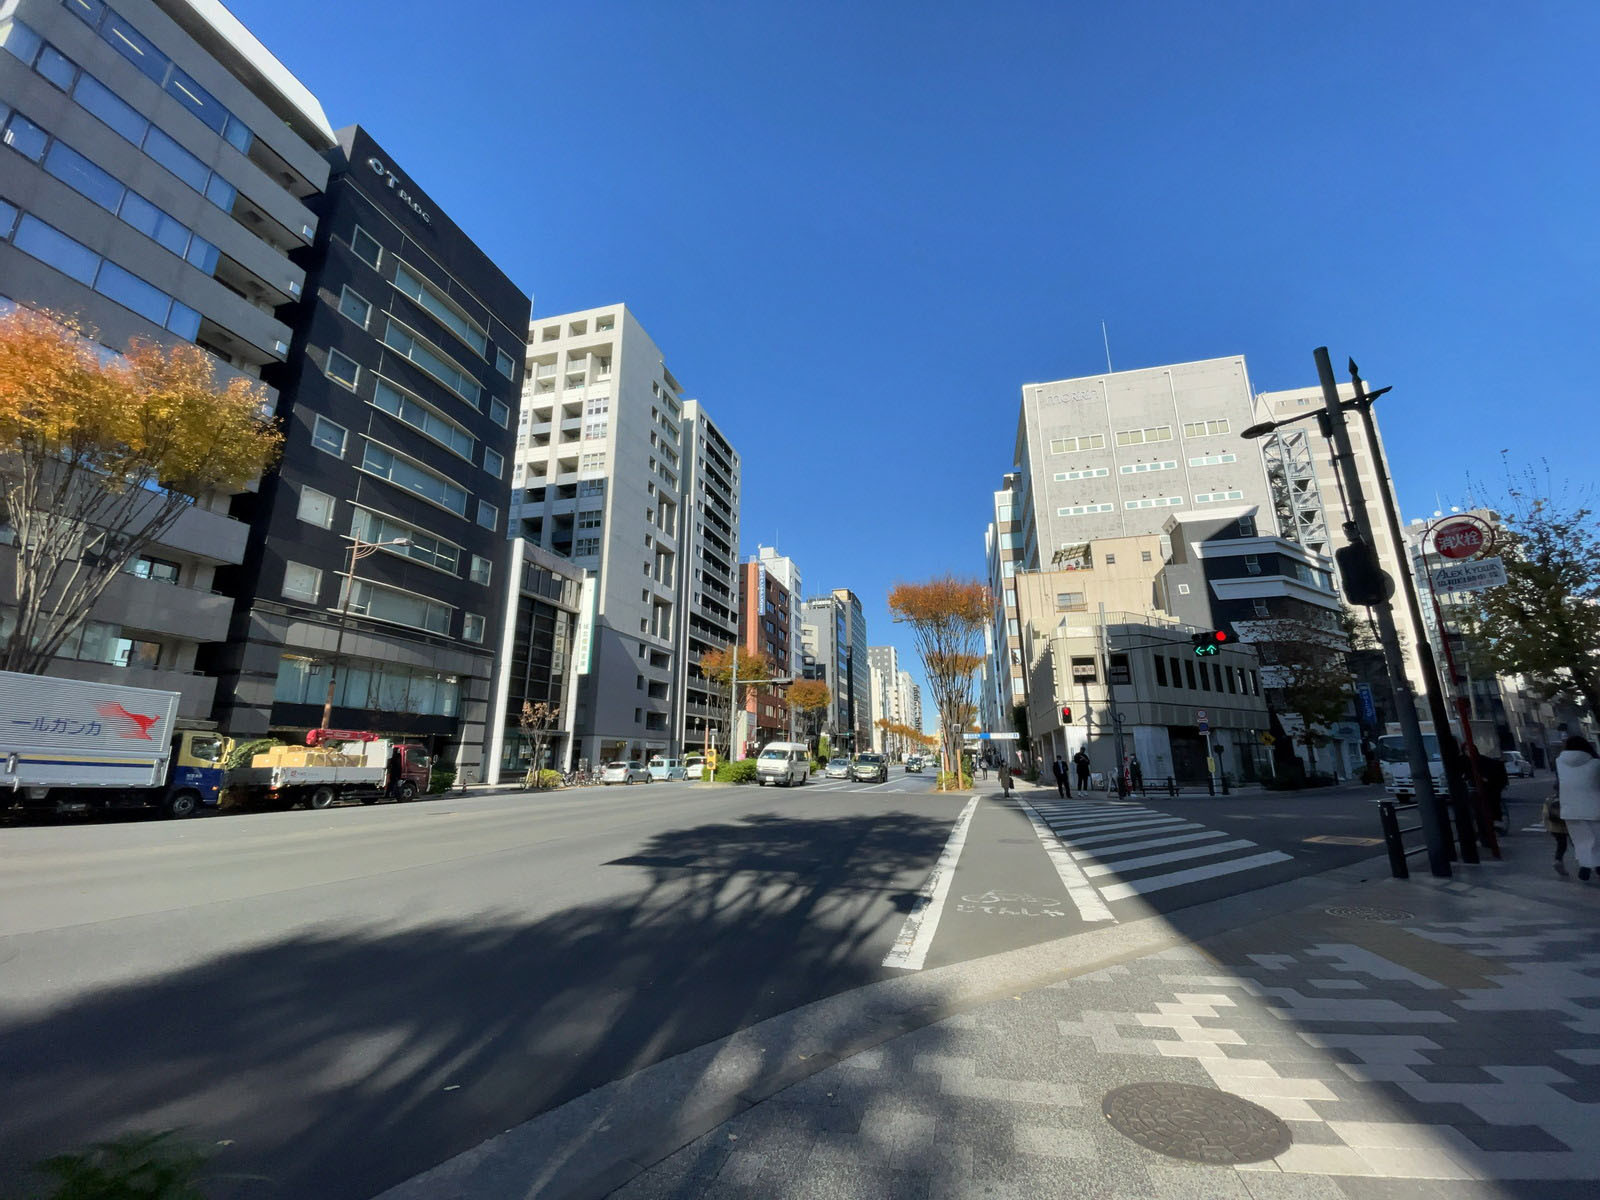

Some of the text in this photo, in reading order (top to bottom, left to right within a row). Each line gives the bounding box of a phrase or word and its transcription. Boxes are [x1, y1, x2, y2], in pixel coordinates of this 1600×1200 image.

[1438, 531, 1480, 550] 消火栓
[1435, 568, 1463, 580] ALEX
